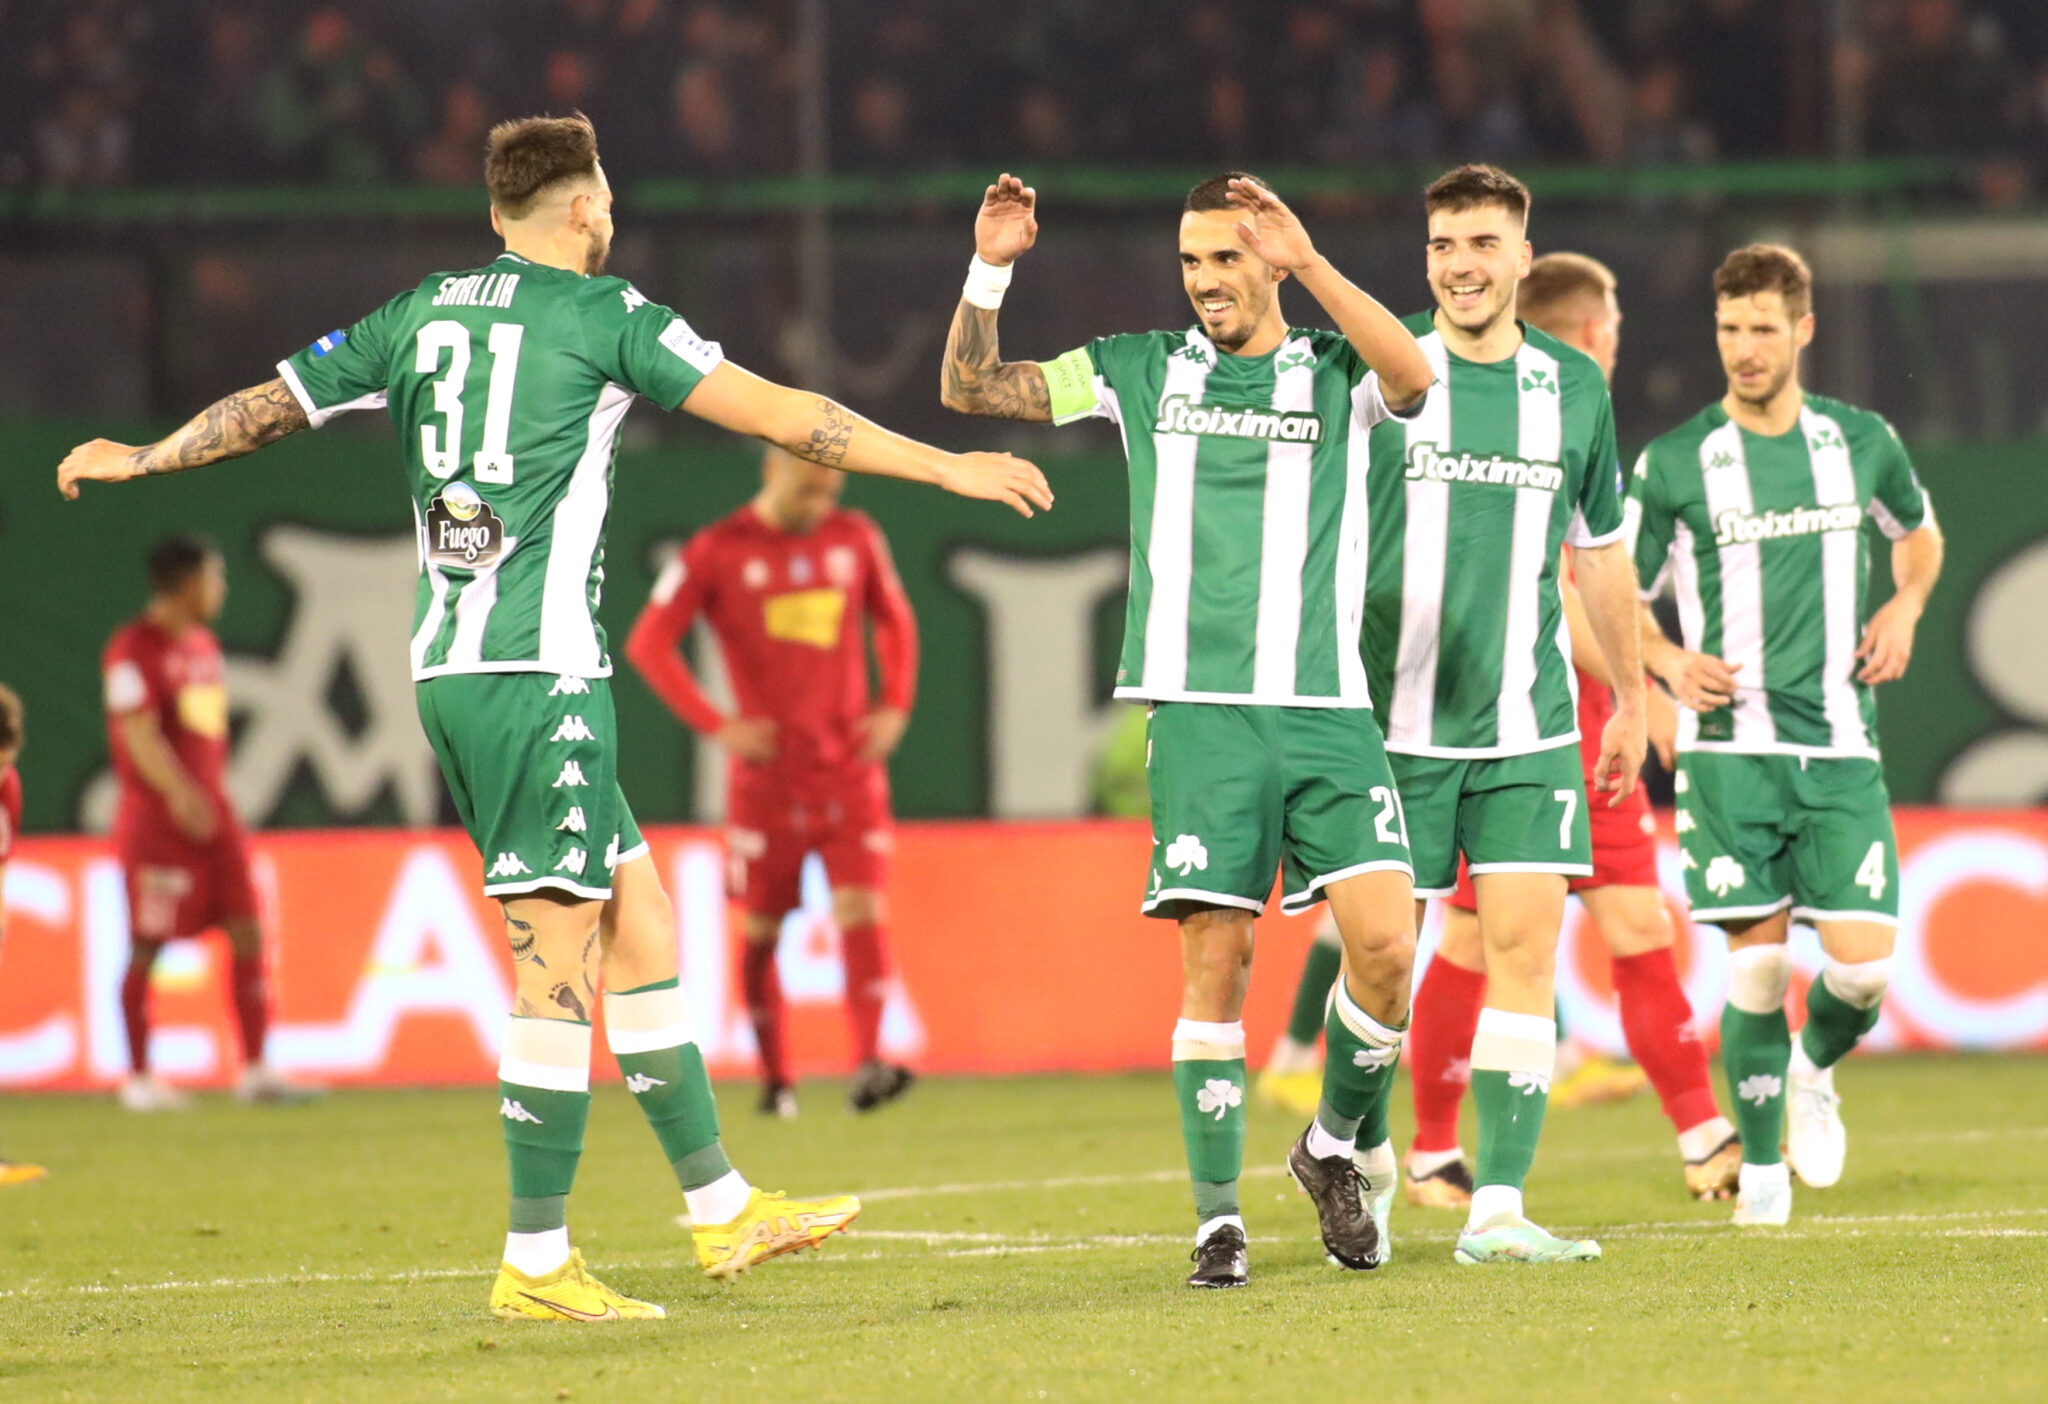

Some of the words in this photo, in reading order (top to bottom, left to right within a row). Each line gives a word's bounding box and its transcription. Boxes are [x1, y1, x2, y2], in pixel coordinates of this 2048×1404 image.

[432, 273, 521, 308] SARLIJA
[415, 320, 525, 485] 31
[1155, 395, 1321, 442] Stoiximan
[1405, 444, 1563, 491] Stoiximan
[438, 520, 490, 561] Fuego
[1715, 506, 1862, 546] Stoiximan
[1553, 789, 1577, 850] 7
[1854, 841, 1887, 900] 4
